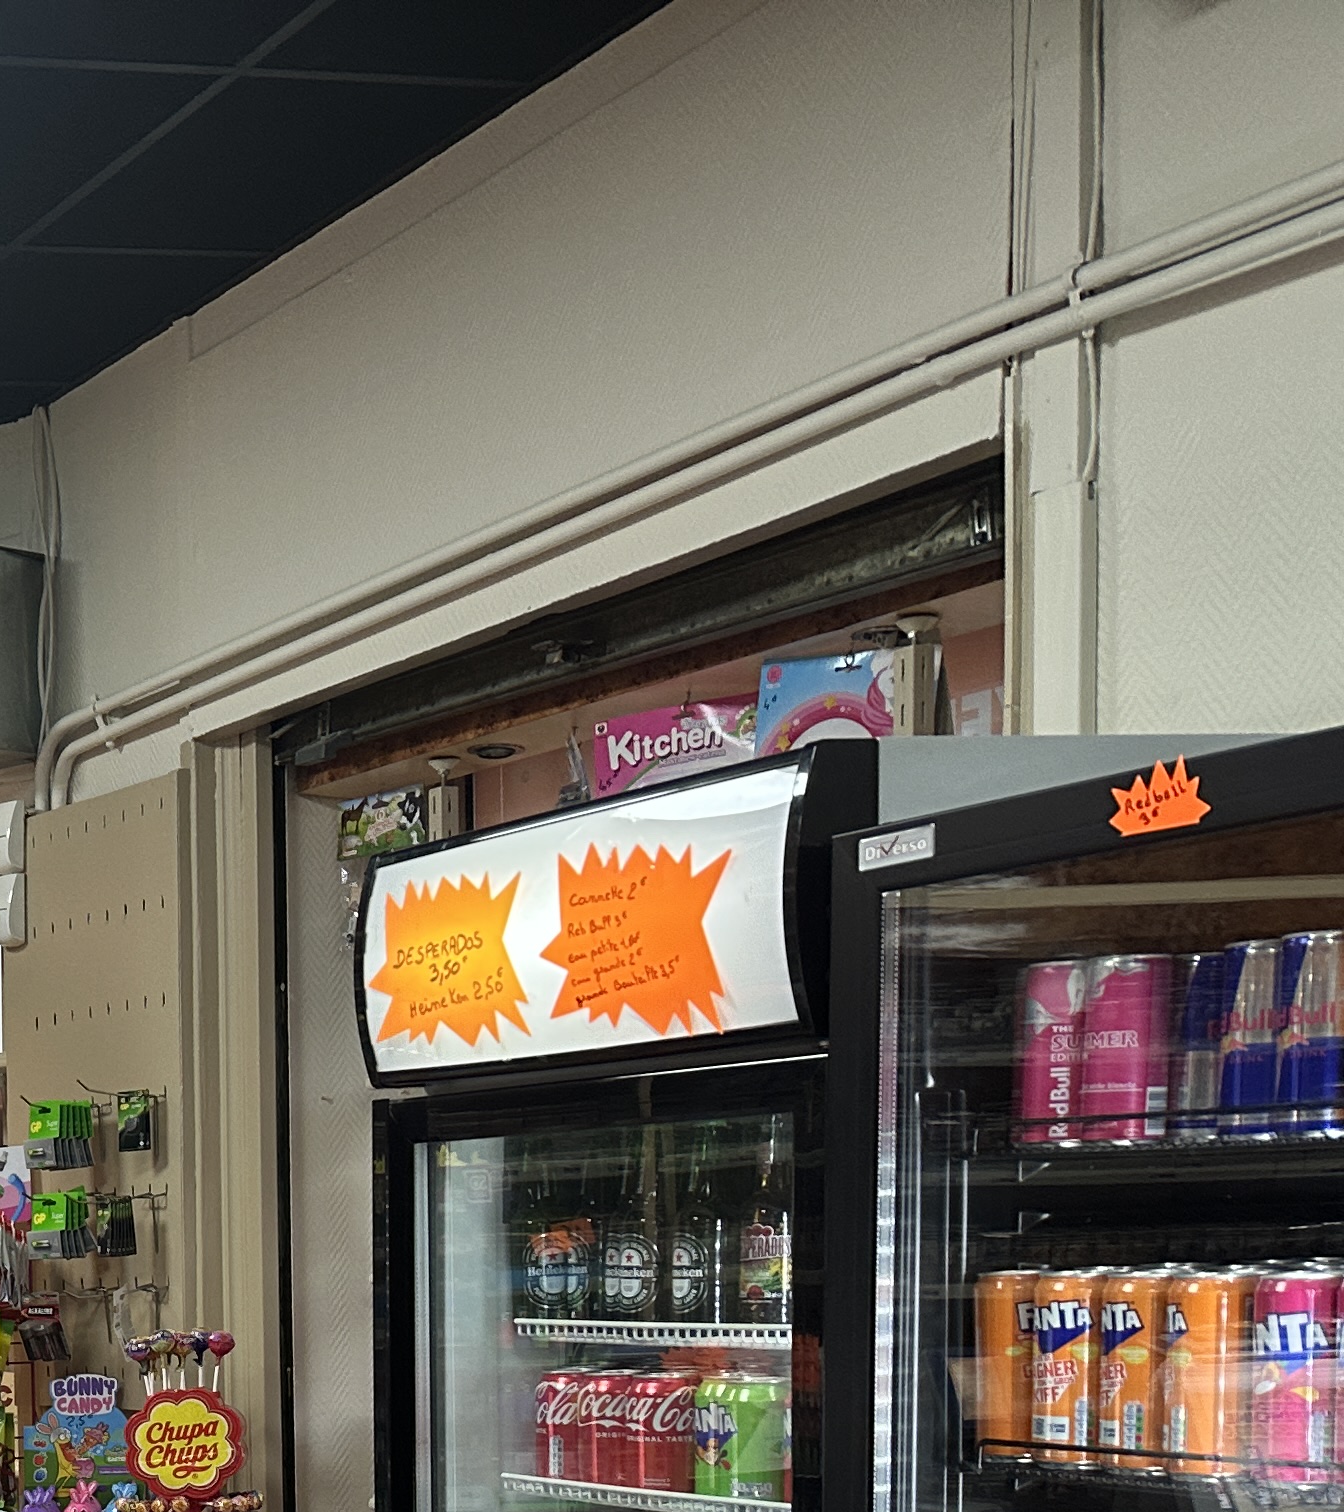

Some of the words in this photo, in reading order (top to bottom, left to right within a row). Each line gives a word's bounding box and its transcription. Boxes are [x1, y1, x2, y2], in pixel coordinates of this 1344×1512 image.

[606, 724, 724, 771] Kitchen
[864, 835, 927, 862] Diverso
[393, 931, 484, 969] DESPERADOS
[30, 1121, 42, 1133] GP
[34, 1212, 46, 1225] GP
[53, 1376, 116, 1397] BUNNY
[55, 1395, 114, 1415] CANDY
[146, 1420, 218, 1445] Chupa
[145, 1441, 220, 1470] Chups
